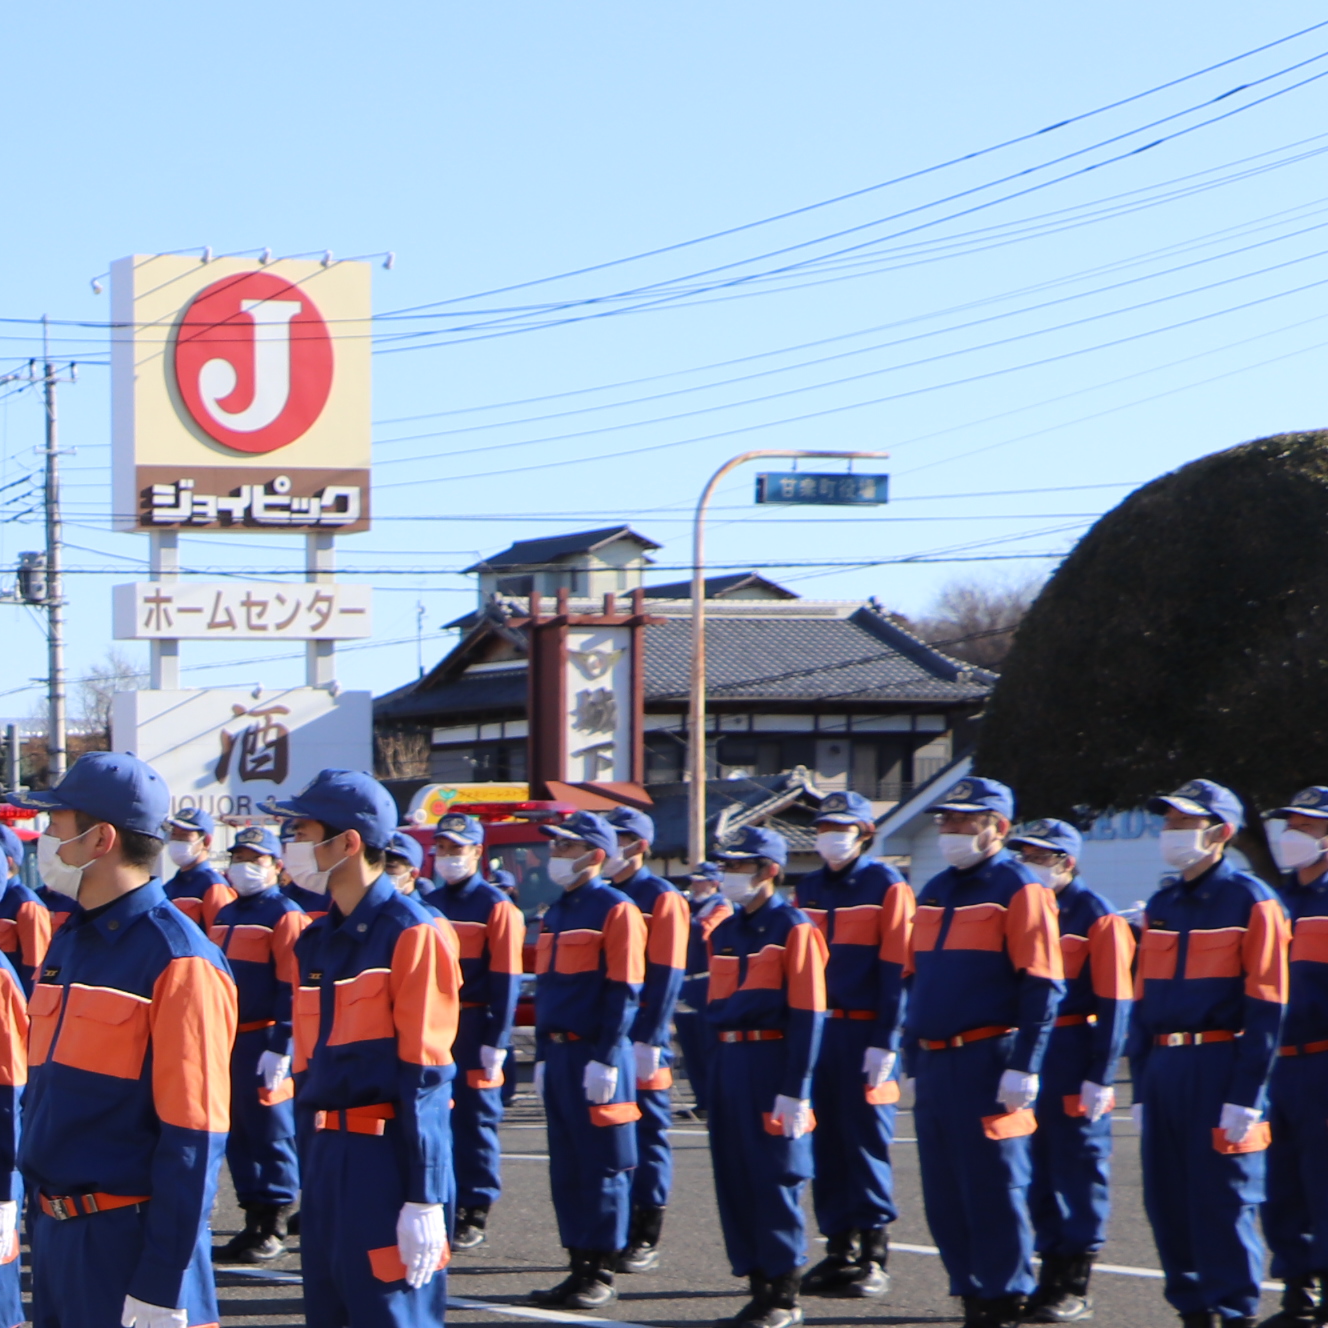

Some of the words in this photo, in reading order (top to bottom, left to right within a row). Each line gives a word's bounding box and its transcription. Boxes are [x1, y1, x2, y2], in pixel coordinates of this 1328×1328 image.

[151, 475, 361, 525] ジョイピック
[142, 587, 367, 632] ホームセンター
[215, 703, 290, 785] 酒
